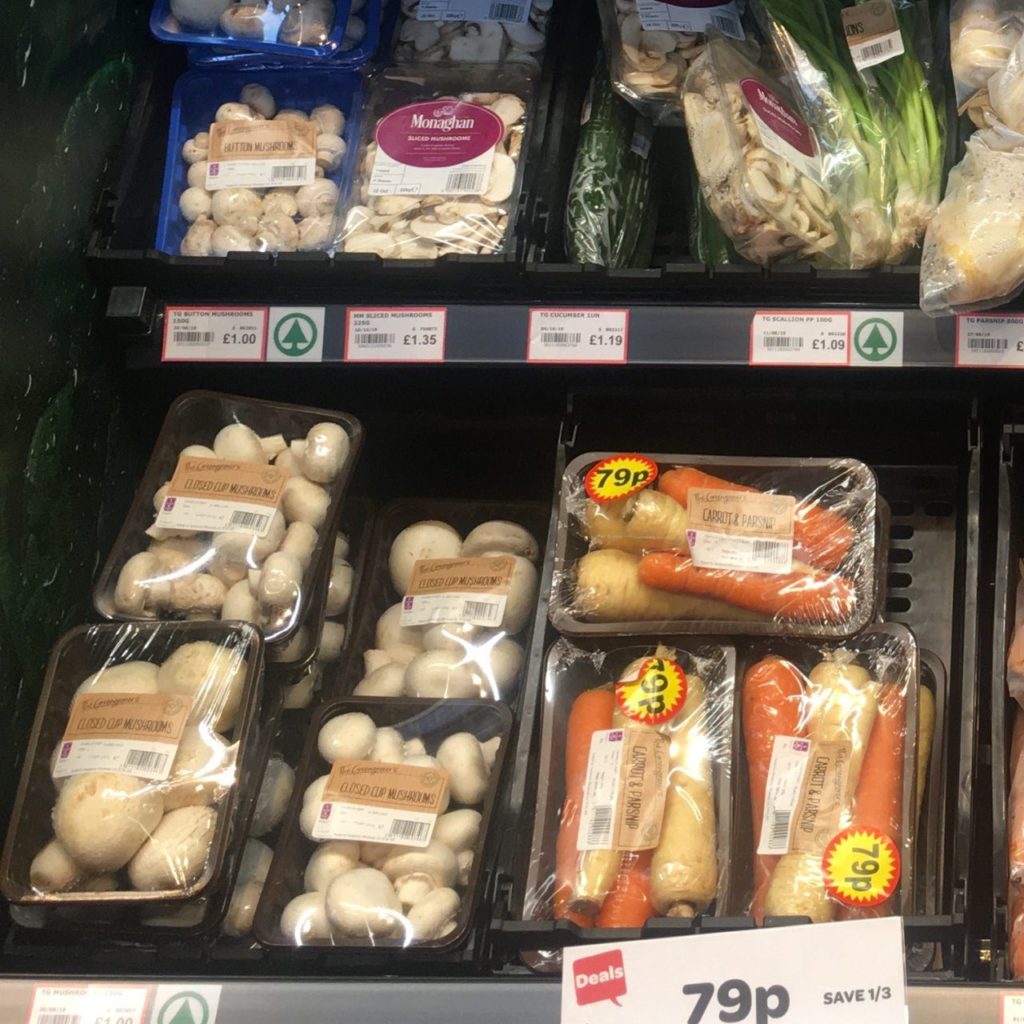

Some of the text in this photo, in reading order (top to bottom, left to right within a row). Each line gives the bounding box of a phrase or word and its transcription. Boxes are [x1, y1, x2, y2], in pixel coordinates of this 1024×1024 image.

[411, 114, 475, 132] Monaghan
[224, 140, 250, 152] BUTTON
[223, 333, 256, 344] £1.00
[403, 335, 437, 345] £1.35
[590, 335, 622, 346] £1.19
[812, 339, 845, 350] £1.09
[596, 468, 649, 488] 79p
[184, 478, 276, 500] CLOSED CUP MUSHROOMS
[641, 660, 666, 714] 79p
[77, 718, 173, 734] CLOSED CUP MUSHROOMS
[340, 782, 436, 804] CLOSED CUP MUSHROOMS
[844, 843, 880, 892] 79p
[575, 968, 625, 988] Deals
[682, 979, 790, 1024] 79p
[823, 986, 892, 1004] SAVE 1/3
